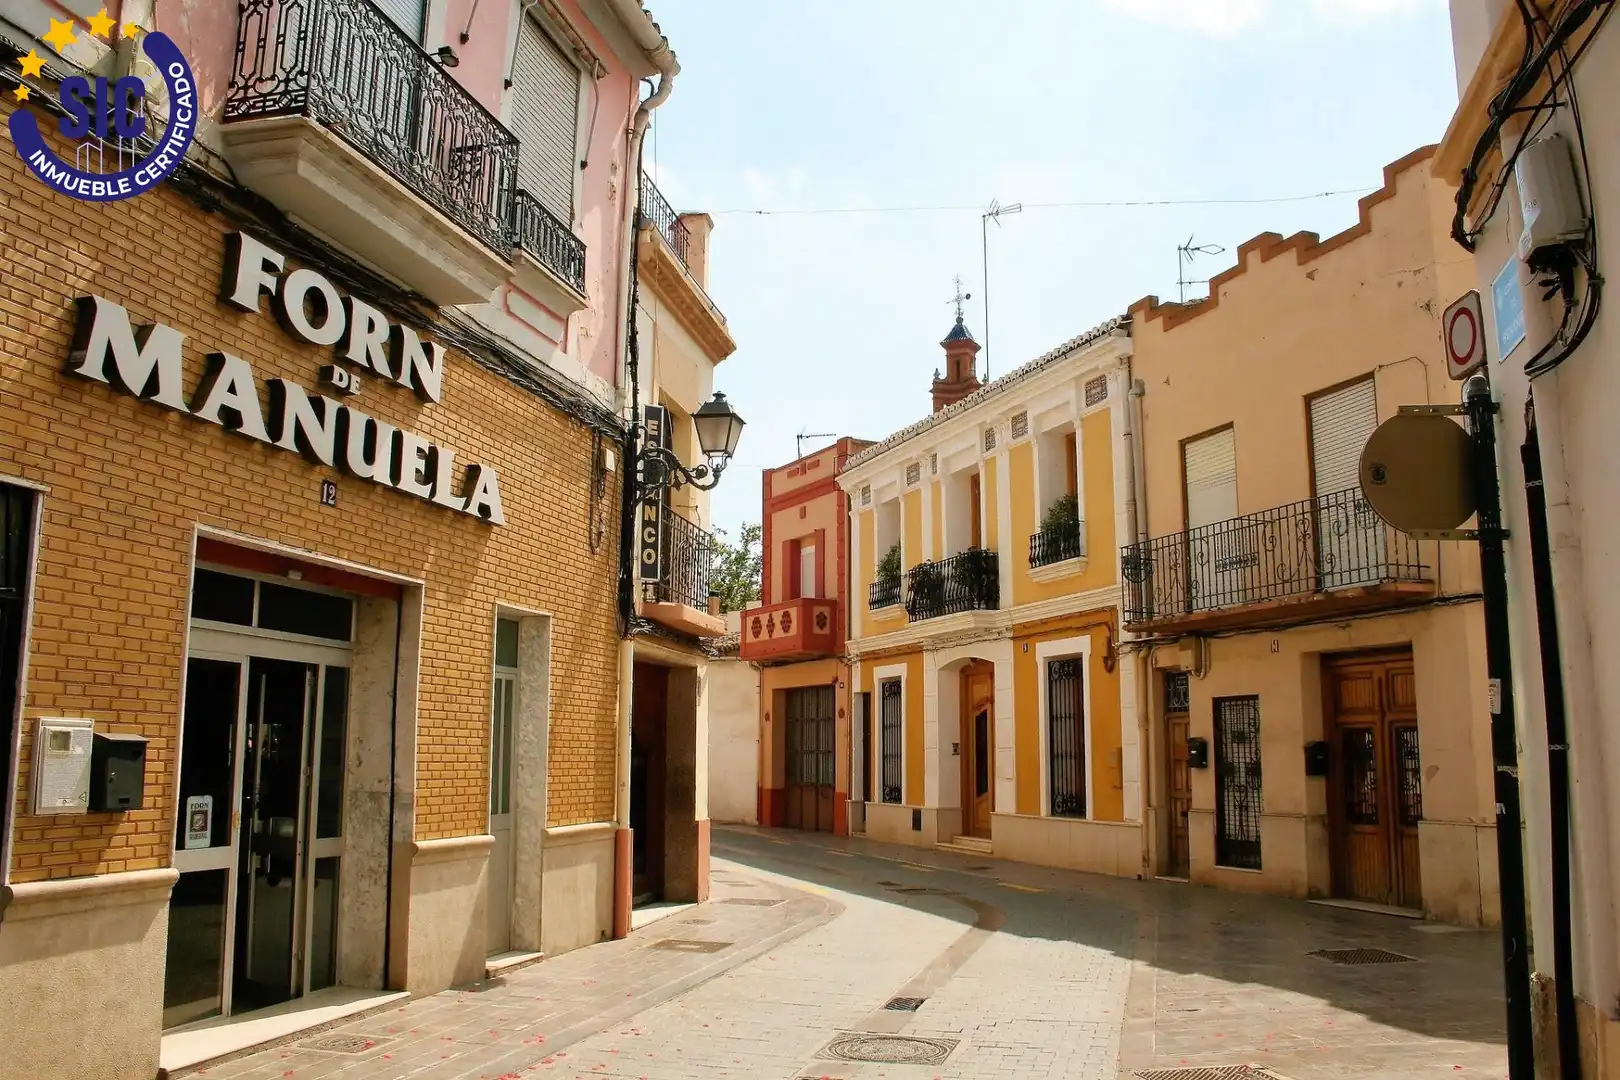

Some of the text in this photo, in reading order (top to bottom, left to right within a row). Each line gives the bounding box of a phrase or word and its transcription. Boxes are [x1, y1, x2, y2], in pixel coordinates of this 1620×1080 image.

[226, 230, 448, 404] FORN
[330, 364, 361, 396] DE
[73, 293, 506, 525] MANUELA
[322, 483, 336, 505] 12
[642, 419, 659, 565] ESNCO
